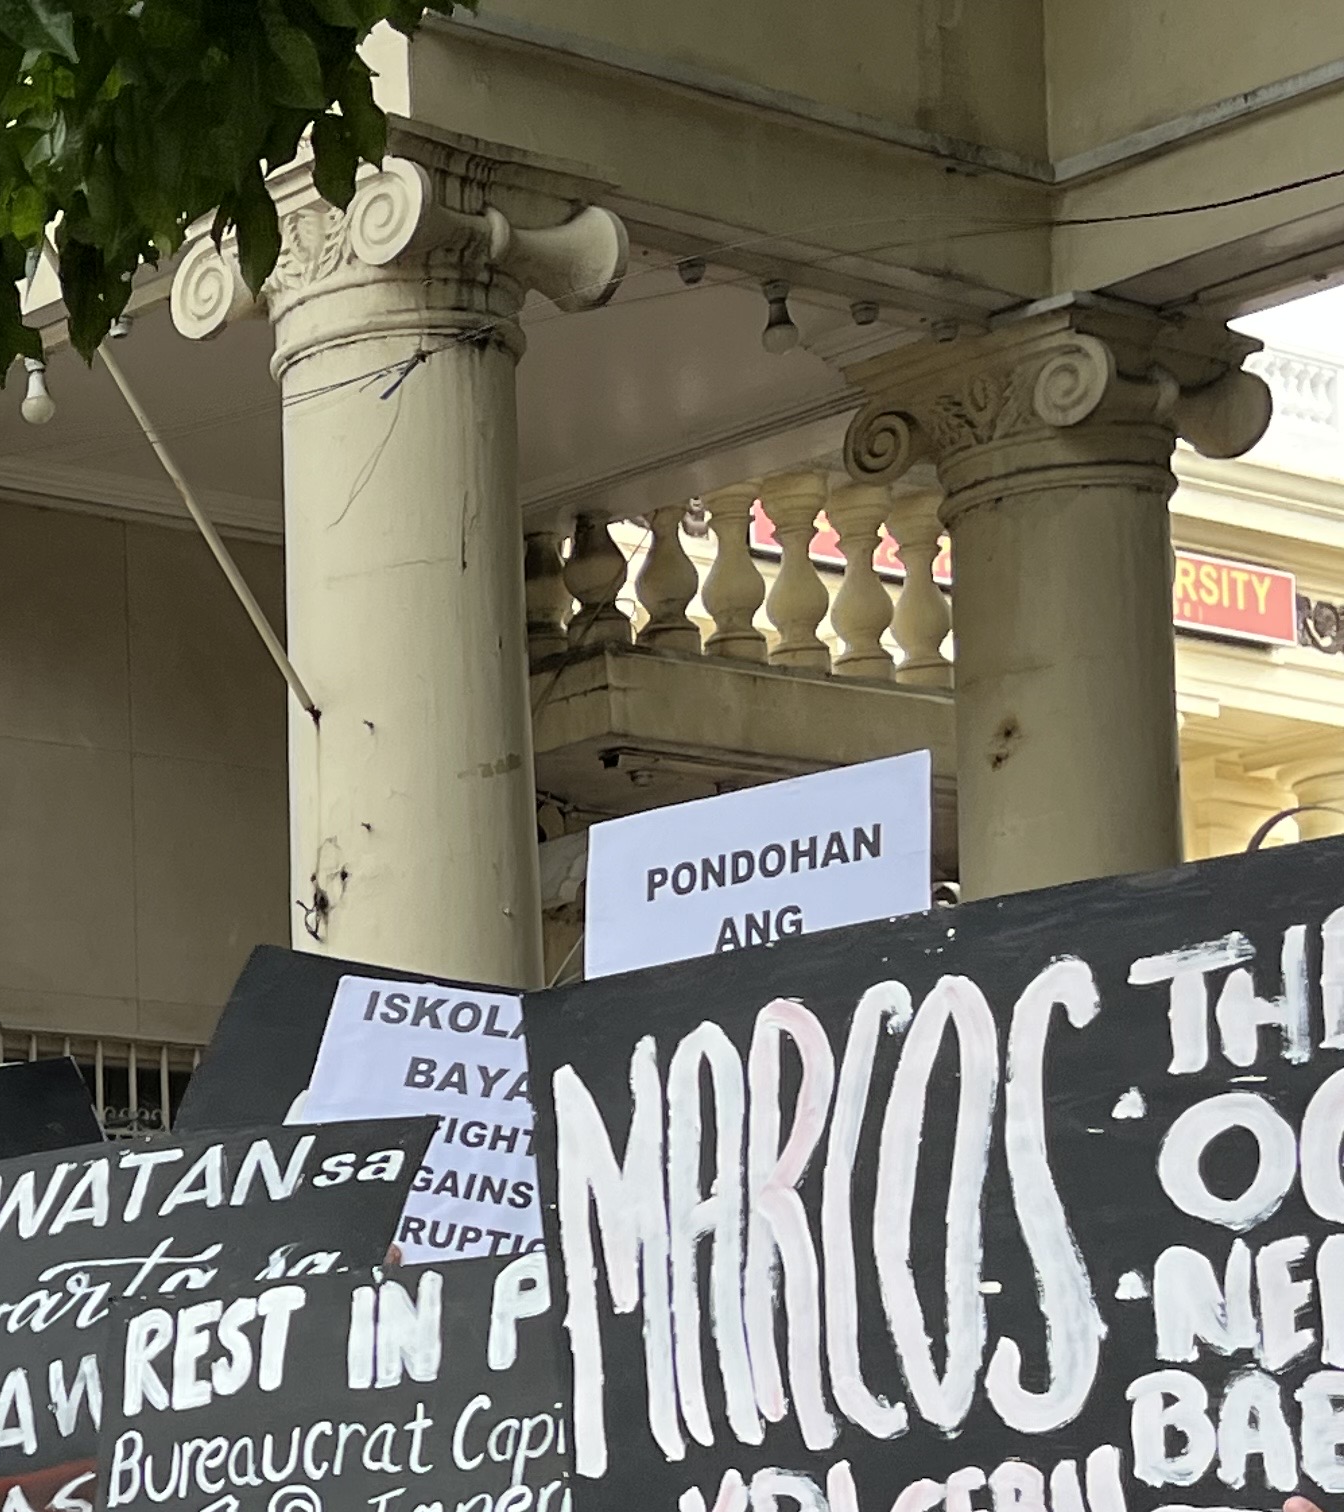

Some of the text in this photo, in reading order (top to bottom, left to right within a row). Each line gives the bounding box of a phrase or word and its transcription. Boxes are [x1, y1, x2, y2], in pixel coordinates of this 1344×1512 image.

[646, 823, 884, 903] PONDOHAN
[716, 904, 804, 954] ANG
[403, 1056, 530, 1101] BAYA
[436, 1115, 537, 1157] IGHT
[312, 1148, 406, 1189] sa
[412, 1166, 534, 1210] GAINS
[552, 954, 1109, 1480] MARCOS
[121, 1286, 307, 1417] REST
[347, 1270, 444, 1389] IN
[107, 1395, 567, 1508] Bureaucrat Capi
